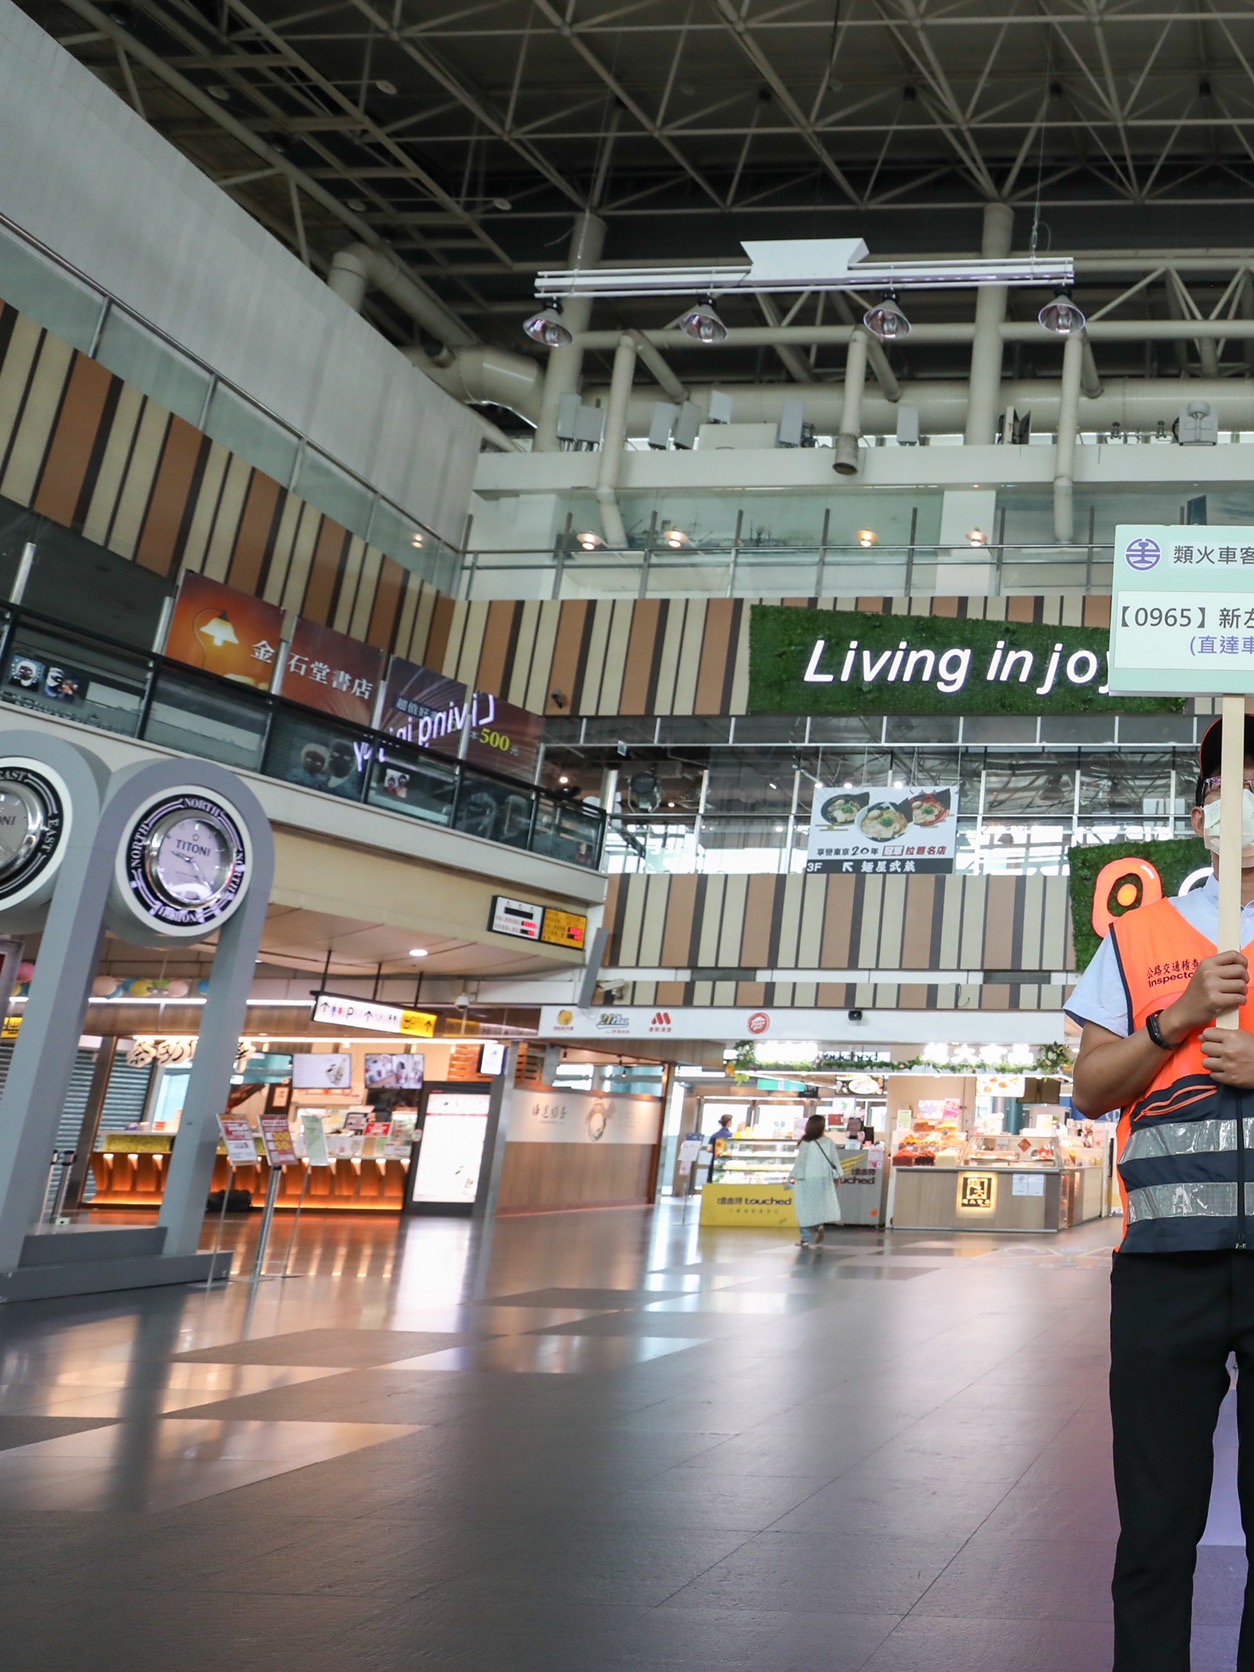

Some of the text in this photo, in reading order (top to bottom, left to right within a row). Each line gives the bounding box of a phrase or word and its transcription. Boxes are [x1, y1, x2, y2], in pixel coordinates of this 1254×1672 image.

[250, 640, 374, 700] 金石堂書店
[803, 639, 972, 693] Living
[184, 798, 223, 818] NORTH
[46, 814, 60, 853] EAST
[131, 821, 151, 868] NORTH
[175, 839, 212, 857] TITONI
[806, 862, 822, 872] 3F
[1148, 970, 1194, 987] Inspecto
[744, 1196, 792, 1206] touched
